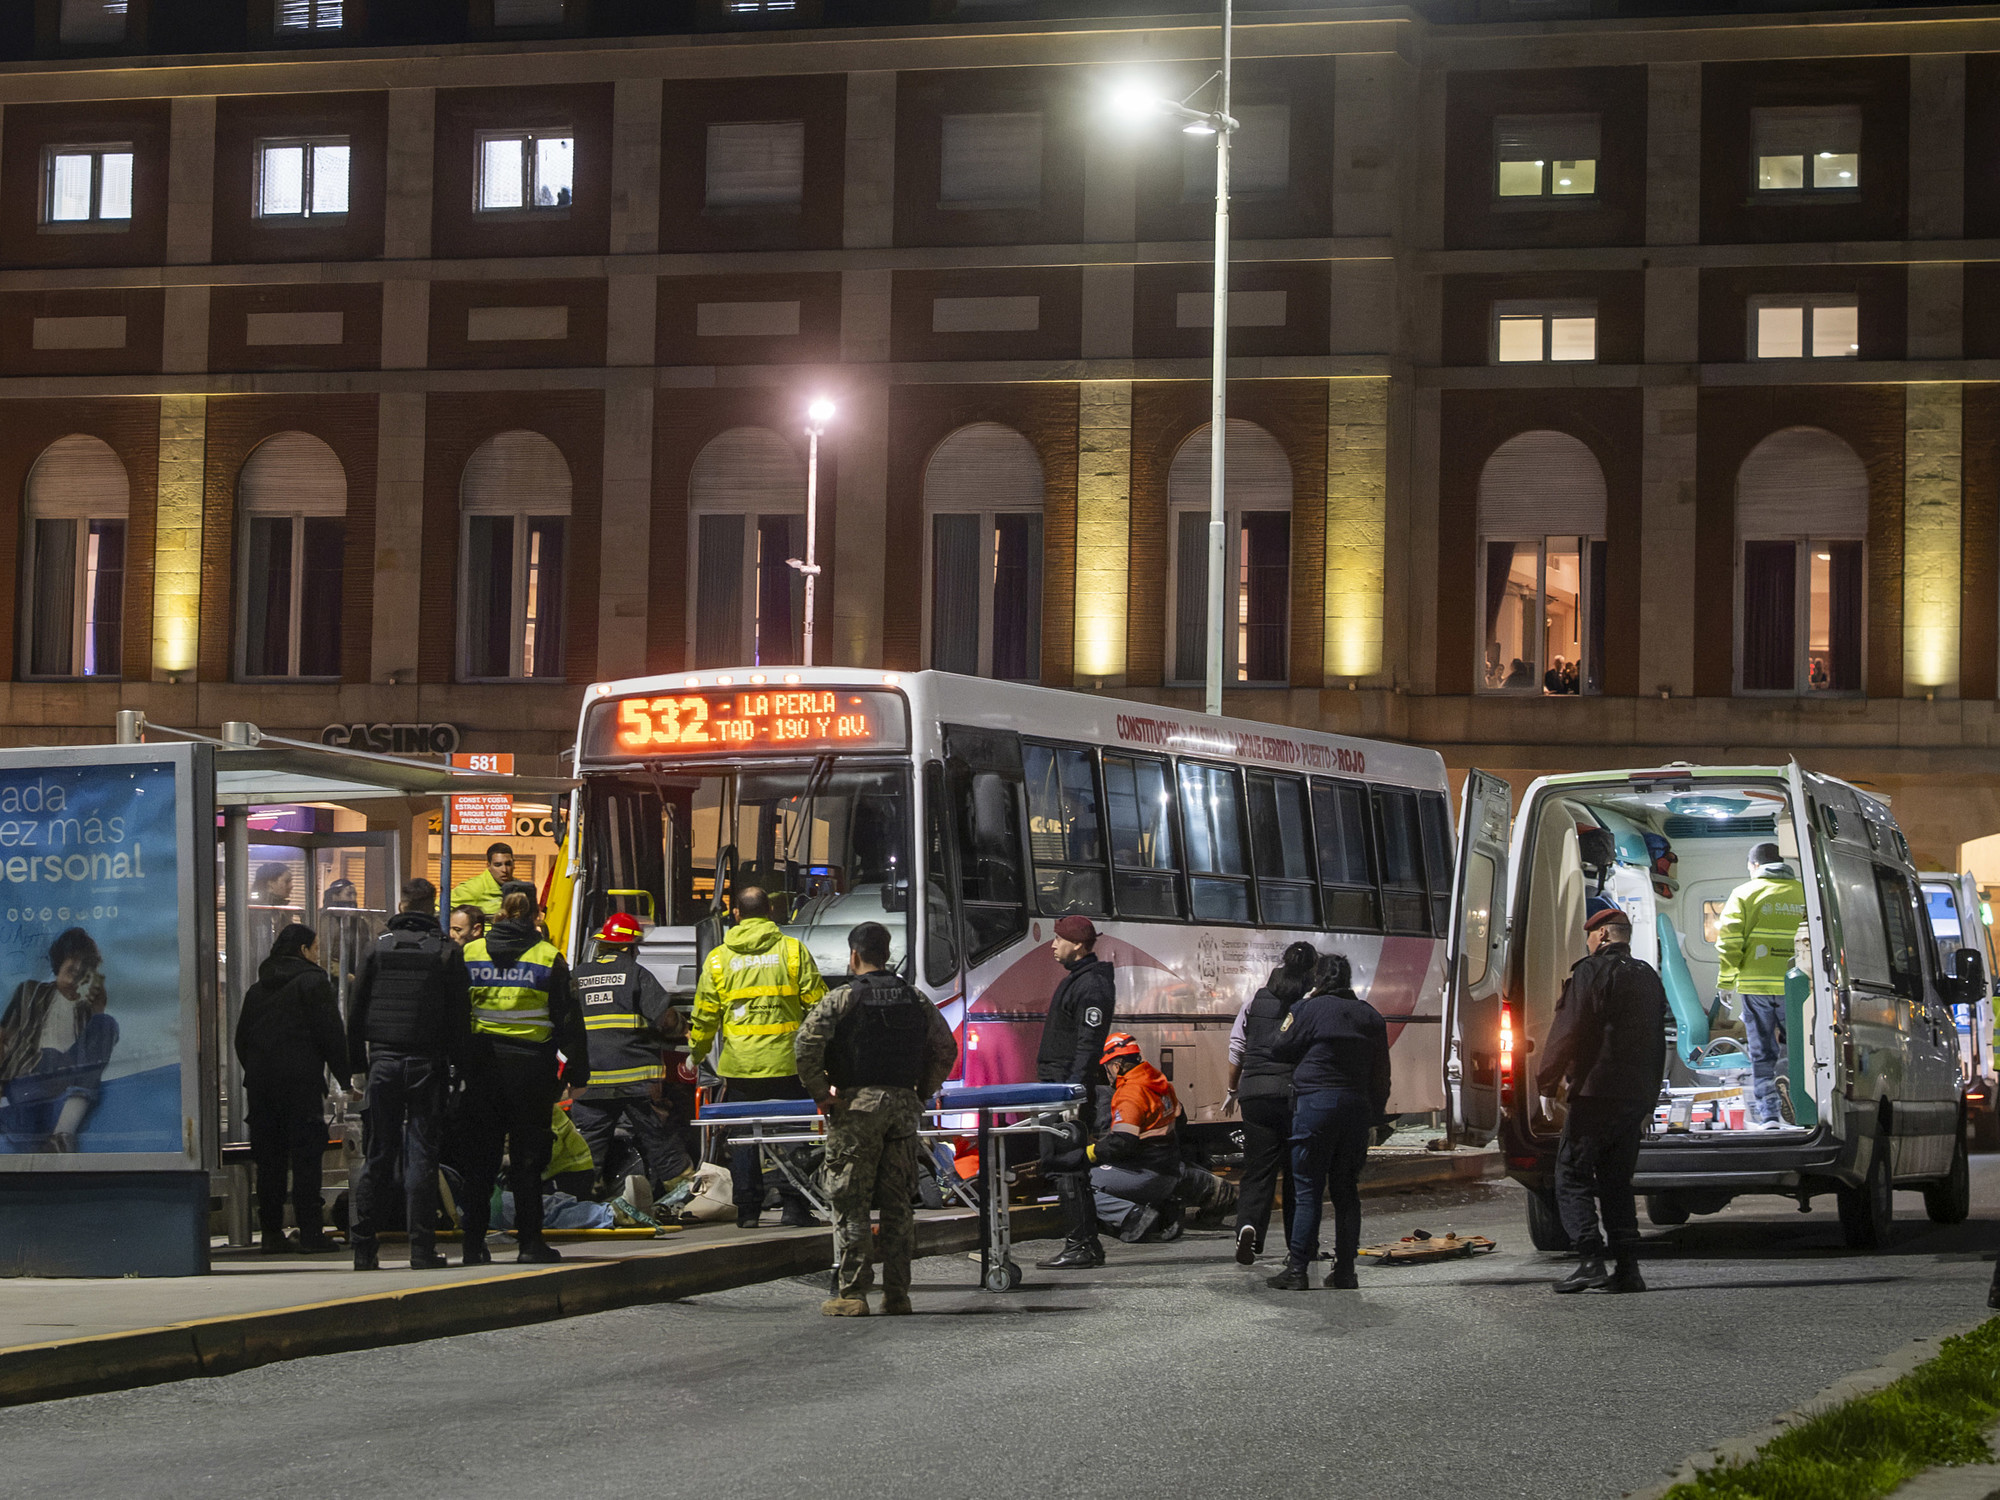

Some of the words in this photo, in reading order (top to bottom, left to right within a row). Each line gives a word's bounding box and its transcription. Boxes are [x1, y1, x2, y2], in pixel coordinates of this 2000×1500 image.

[744, 696, 769, 716] LA
[775, 693, 835, 715] PERLA
[623, 697, 709, 744] 532
[776, 718, 809, 739] 190
[816, 716, 831, 737] Y
[838, 715, 870, 736] AV.
[321, 723, 459, 756] CASINO
[469, 755, 498, 770] 581
[1337, 748, 1365, 774] ROJO
[48, 809, 125, 845] más
[745, 954, 779, 966] SAME
[470, 967, 534, 983] POLICIA
[579, 974, 623, 987] BOMBEROS
[587, 992, 612, 1004] P.B.A.
